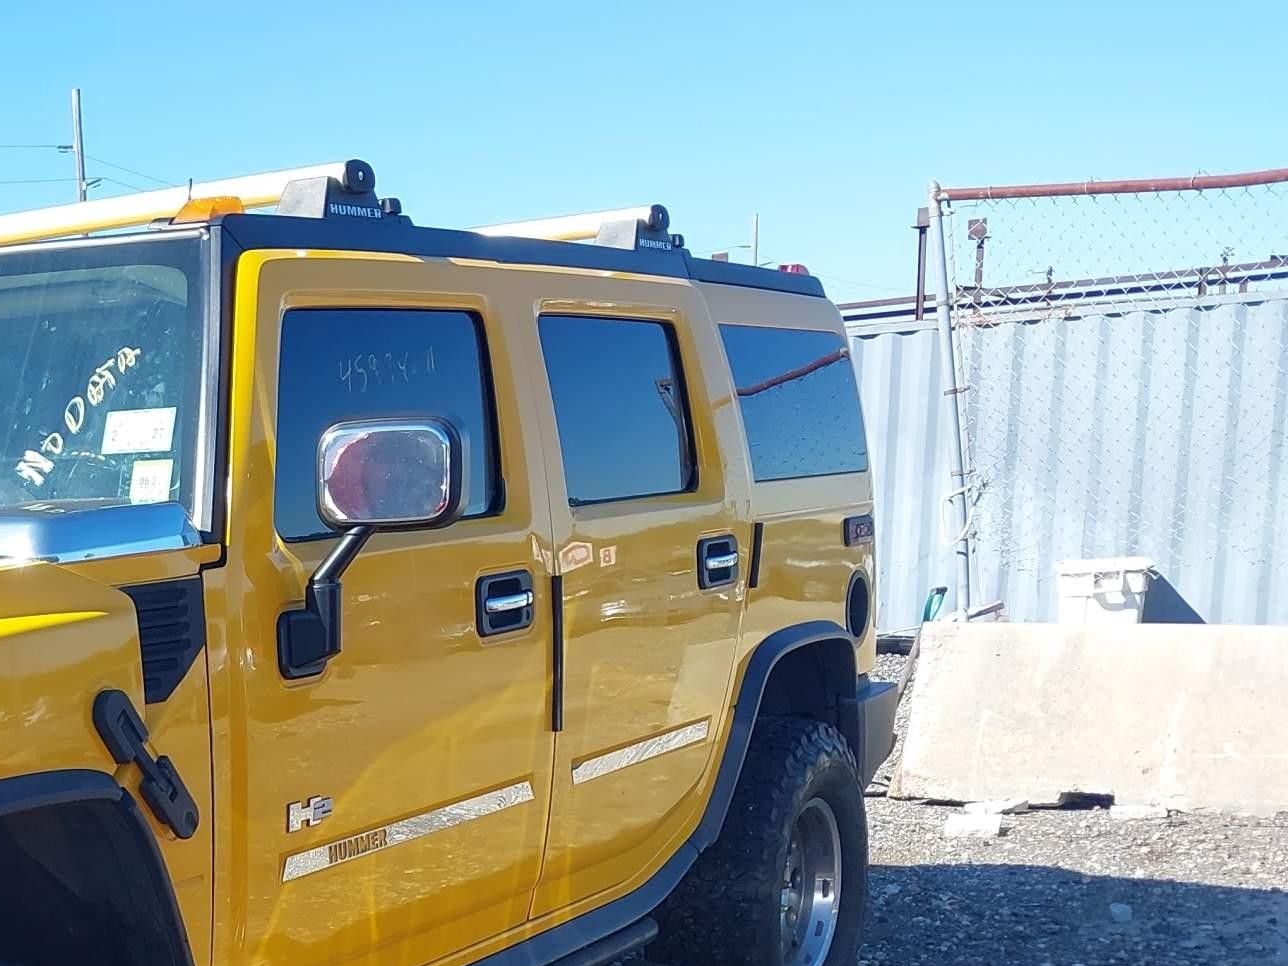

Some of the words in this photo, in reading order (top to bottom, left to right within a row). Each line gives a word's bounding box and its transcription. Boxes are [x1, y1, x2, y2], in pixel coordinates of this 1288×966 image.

[329, 203, 382, 219] HUMMER
[286, 795, 334, 833] H2
[327, 828, 388, 864] HUMMER
